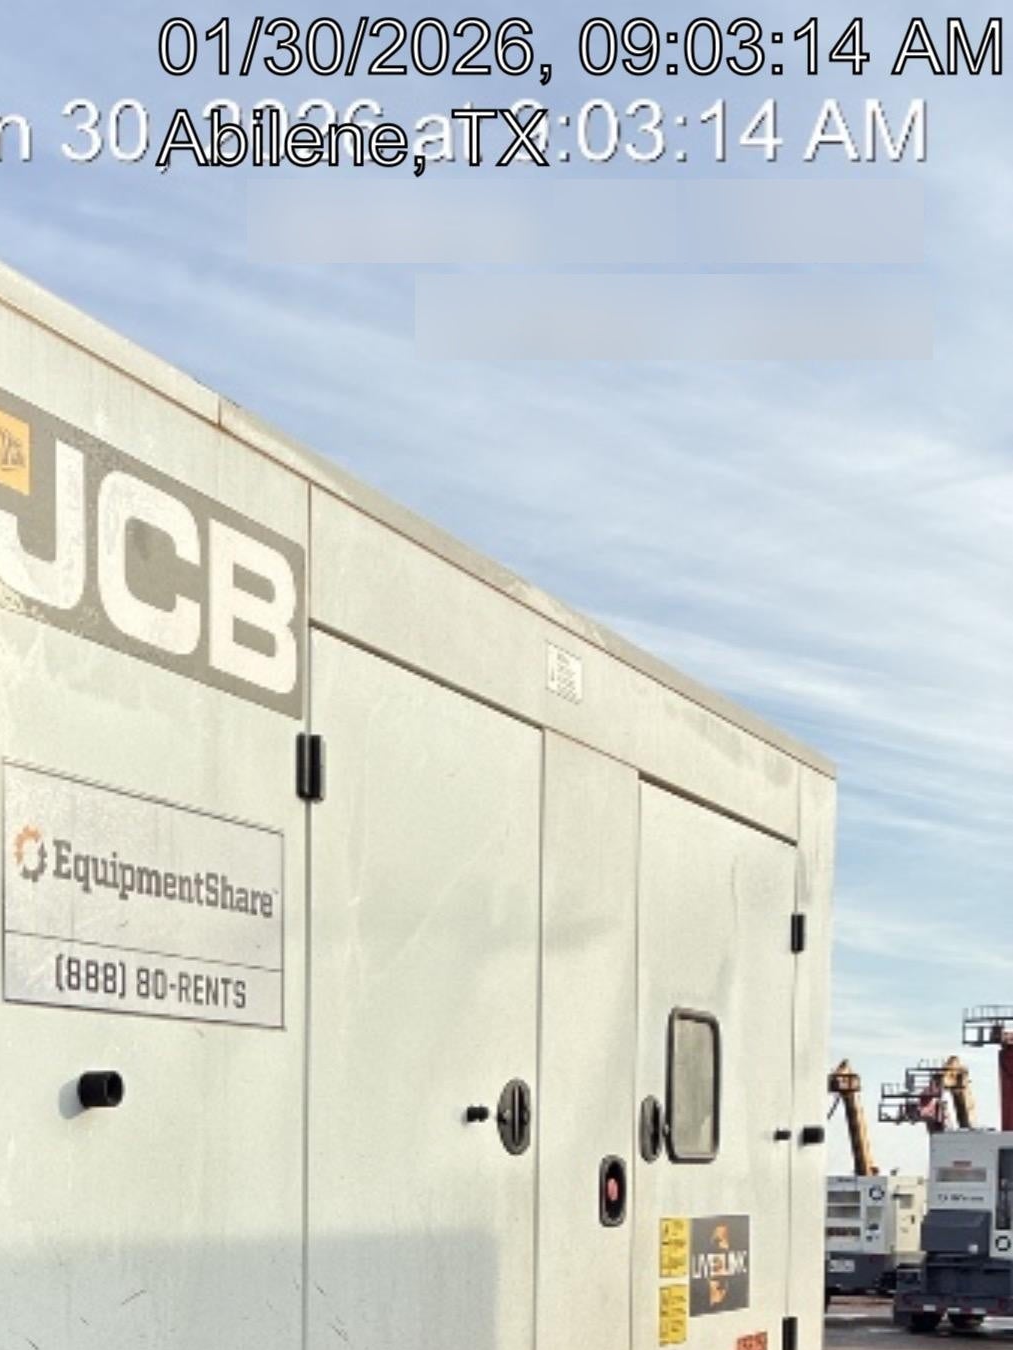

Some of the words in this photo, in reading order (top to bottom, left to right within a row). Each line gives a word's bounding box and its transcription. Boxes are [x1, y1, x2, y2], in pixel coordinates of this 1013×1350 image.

[53, 839, 274, 918] EquipmentShare
[55, 953, 126, 1000] (888)
[137, 966, 246, 1010] 80-RENTS
